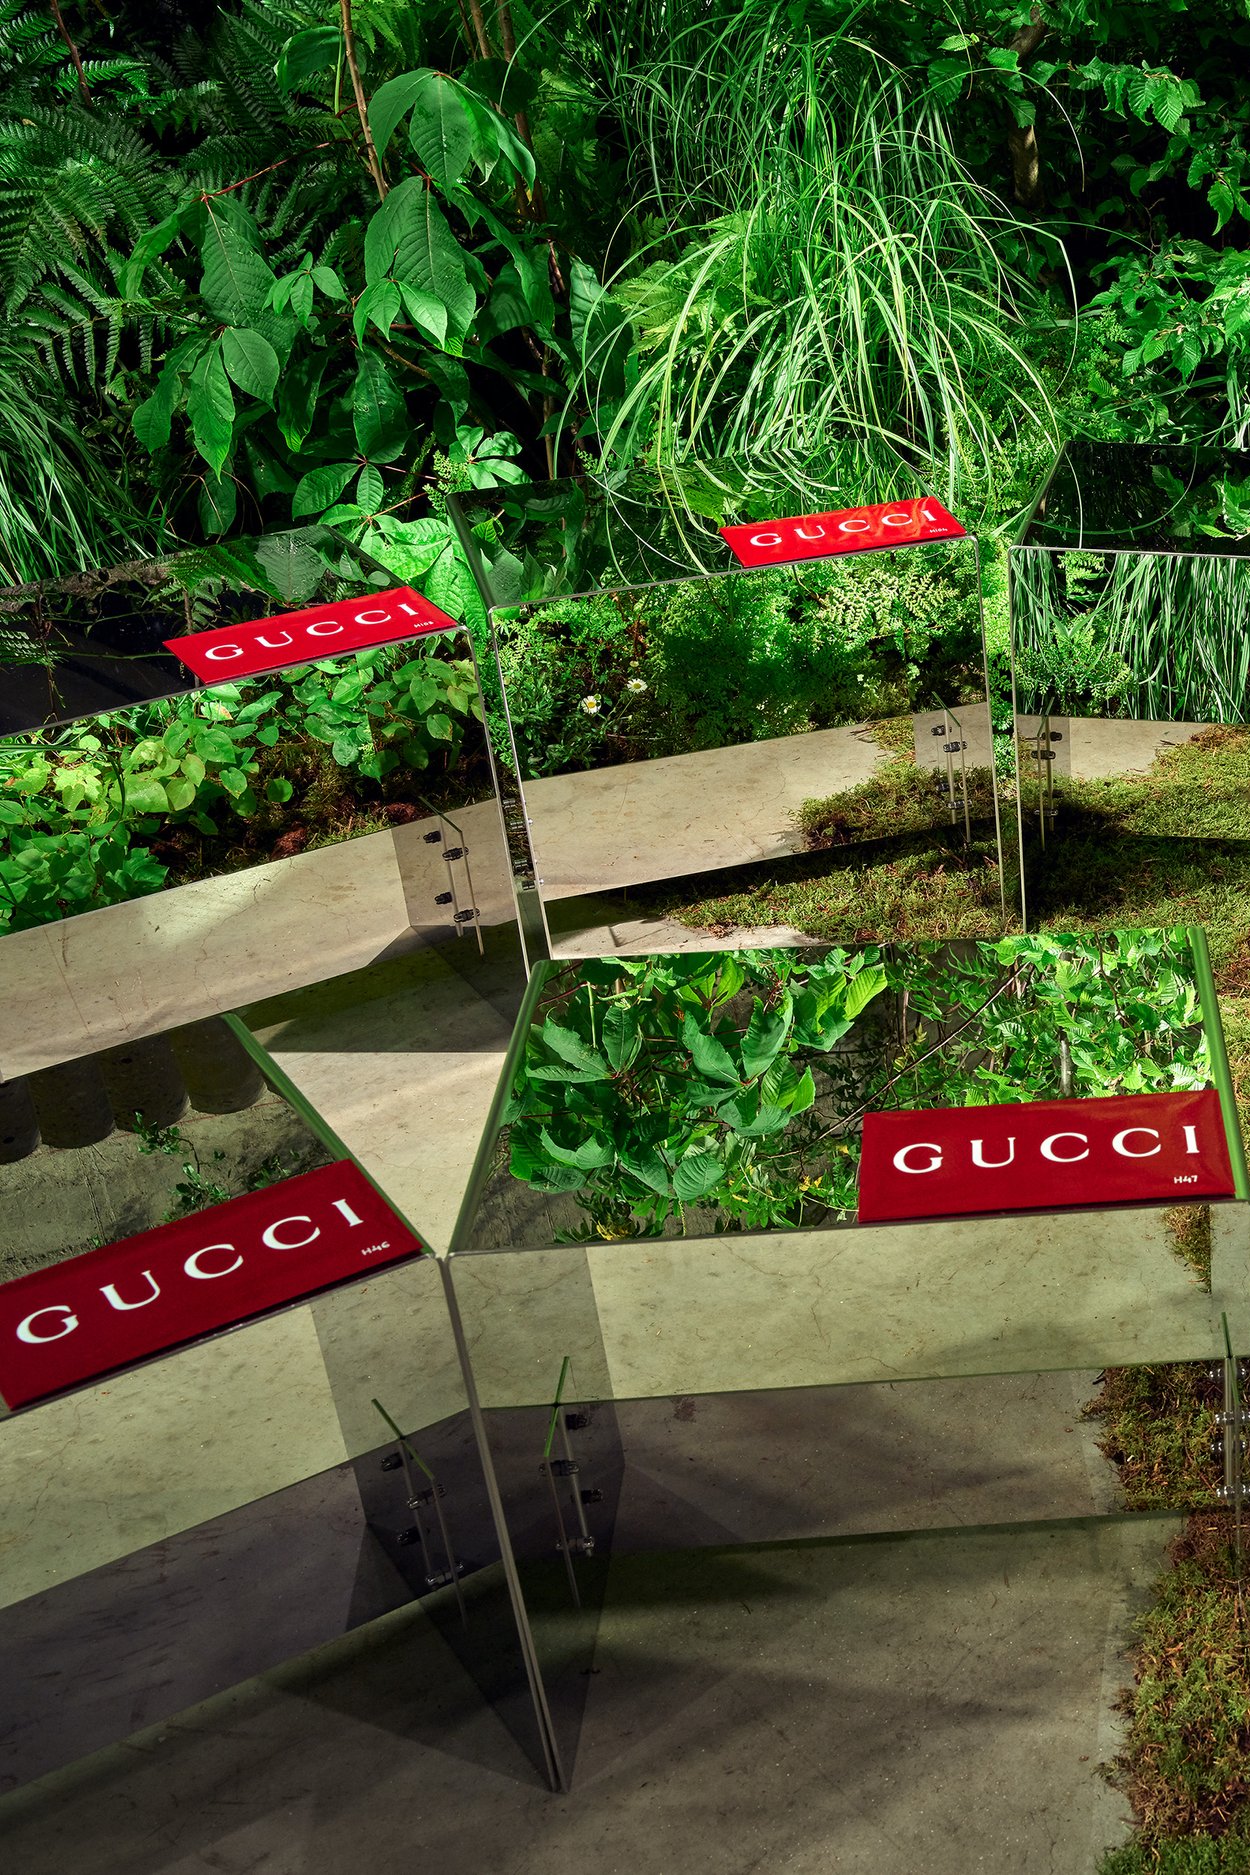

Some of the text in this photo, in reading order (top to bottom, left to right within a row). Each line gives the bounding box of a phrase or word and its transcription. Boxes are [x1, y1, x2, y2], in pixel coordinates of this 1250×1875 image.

[749, 509, 938, 547] GUCCI
[204, 603, 419, 661] GUCCI
[891, 1125, 1201, 1174] GUCCI
[1172, 1174, 1199, 1184] H47
[15, 1198, 365, 1344] GUCCI
